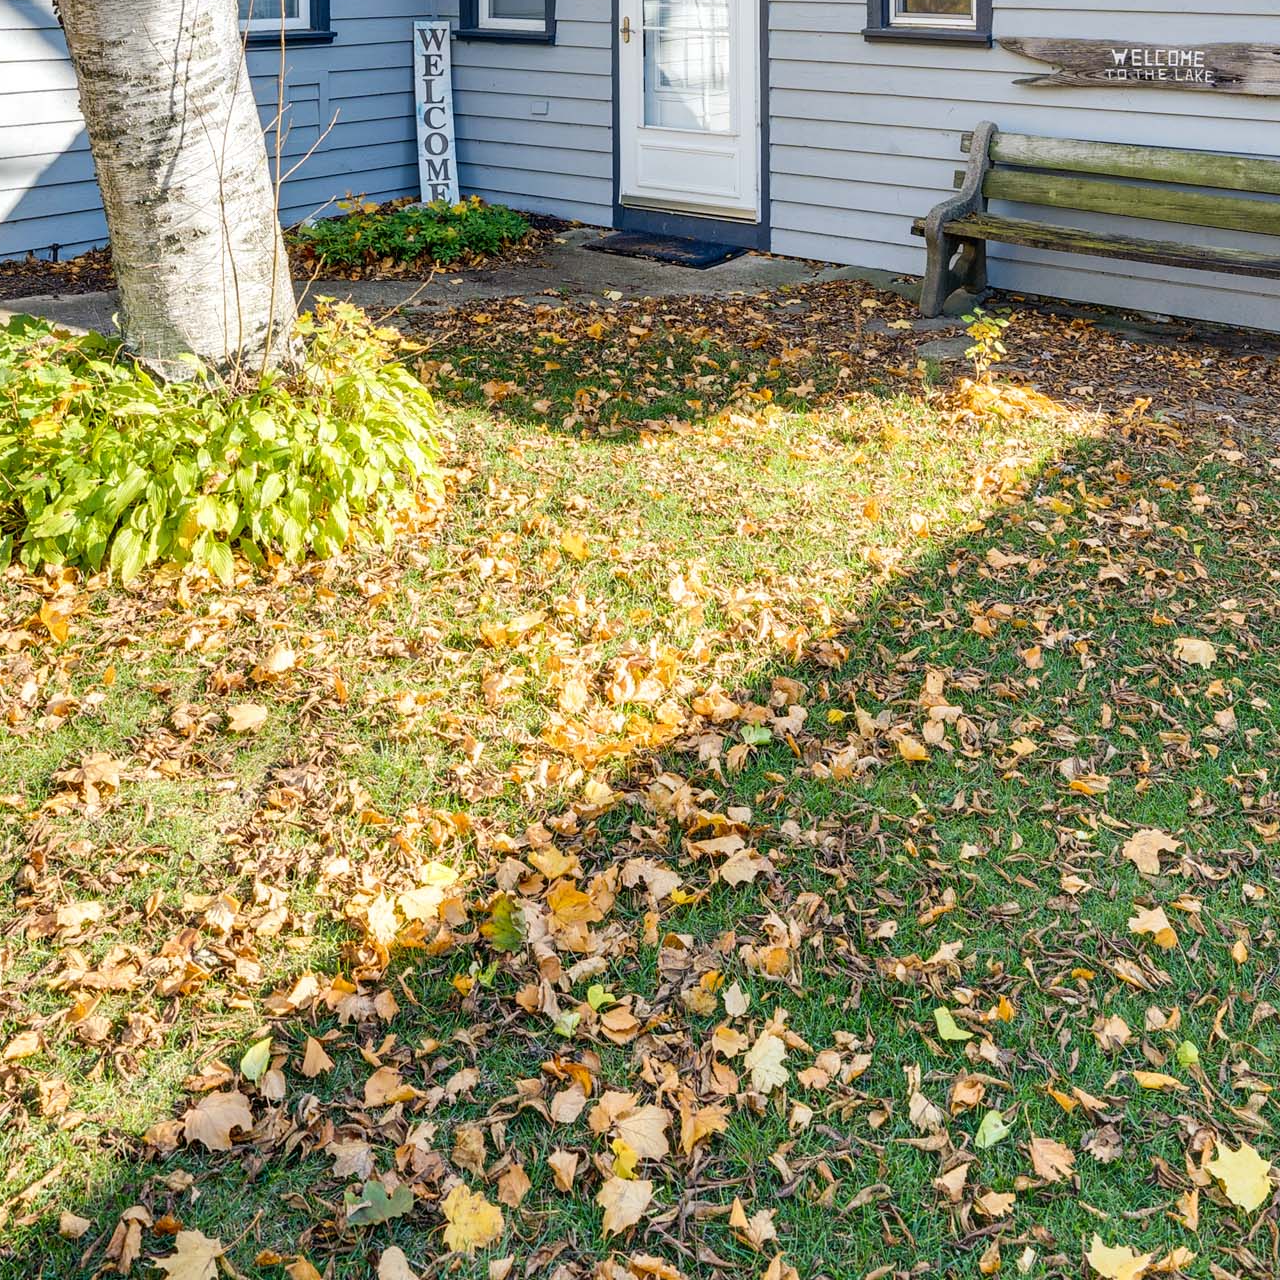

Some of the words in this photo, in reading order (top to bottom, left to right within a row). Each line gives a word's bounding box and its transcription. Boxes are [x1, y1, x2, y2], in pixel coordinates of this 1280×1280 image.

[1111, 48, 1205, 68] WELCOME
[1104, 68, 1127, 80] TO
[1132, 68, 1169, 81] THE
[1175, 68, 1216, 83] LAKE
[416, 28, 452, 204] WELCOME
